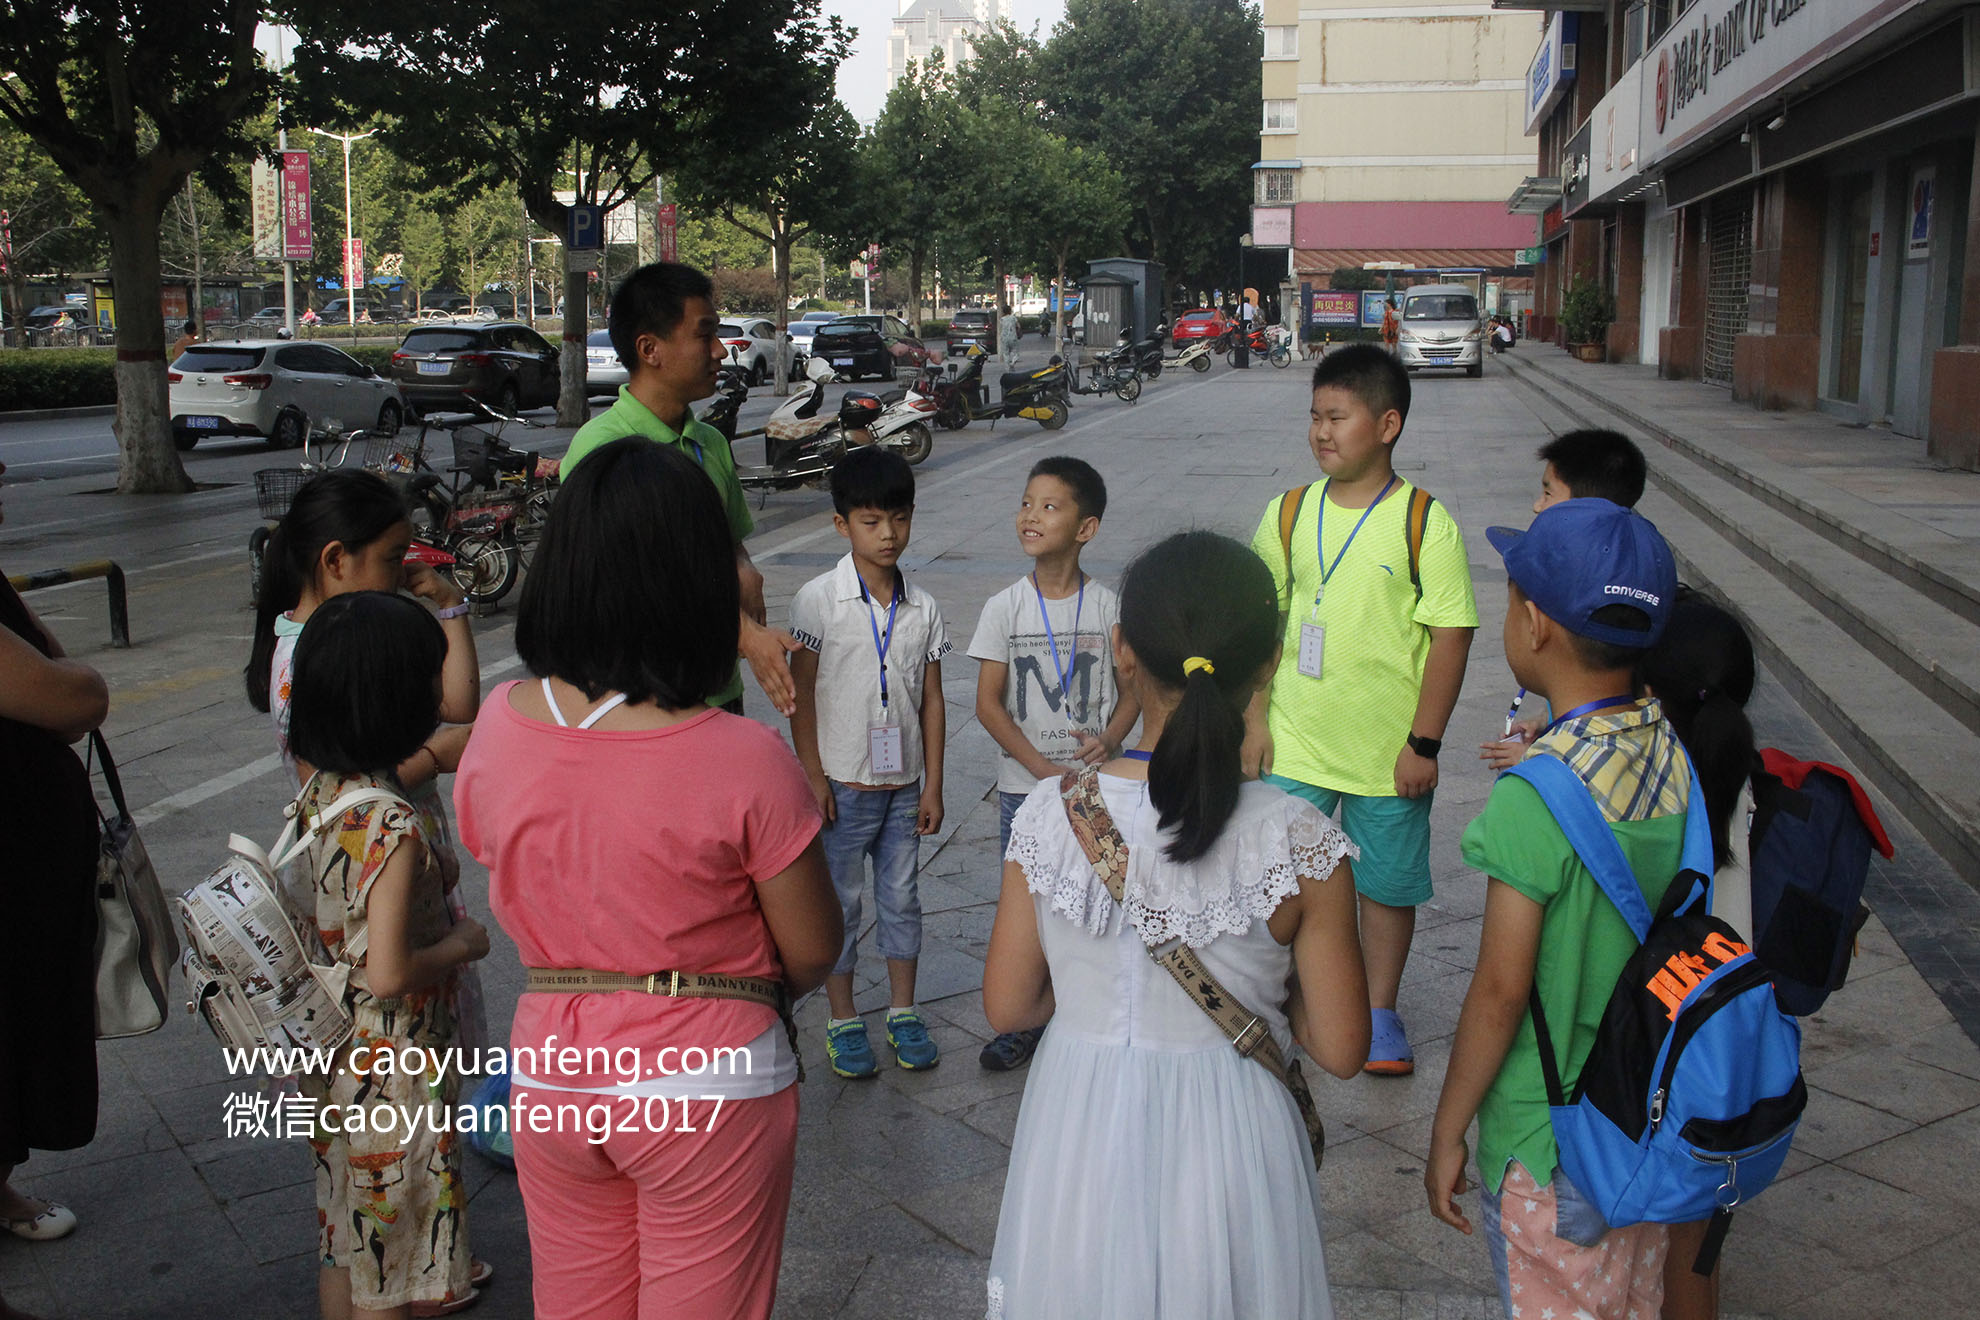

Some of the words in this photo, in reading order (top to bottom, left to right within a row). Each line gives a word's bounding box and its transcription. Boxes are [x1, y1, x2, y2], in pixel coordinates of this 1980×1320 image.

[1712, 0, 1746, 76] BANK
[1670, 14, 1711, 119] 中国银行
[574, 209, 592, 246] P
[1604, 585, 1660, 606] CONVERSE
[795, 628, 823, 652] STYL
[1014, 651, 1099, 724] M
[1041, 727, 1099, 740] FASON
[557, 975, 588, 984] SERIES
[698, 976, 748, 991] DANNY
